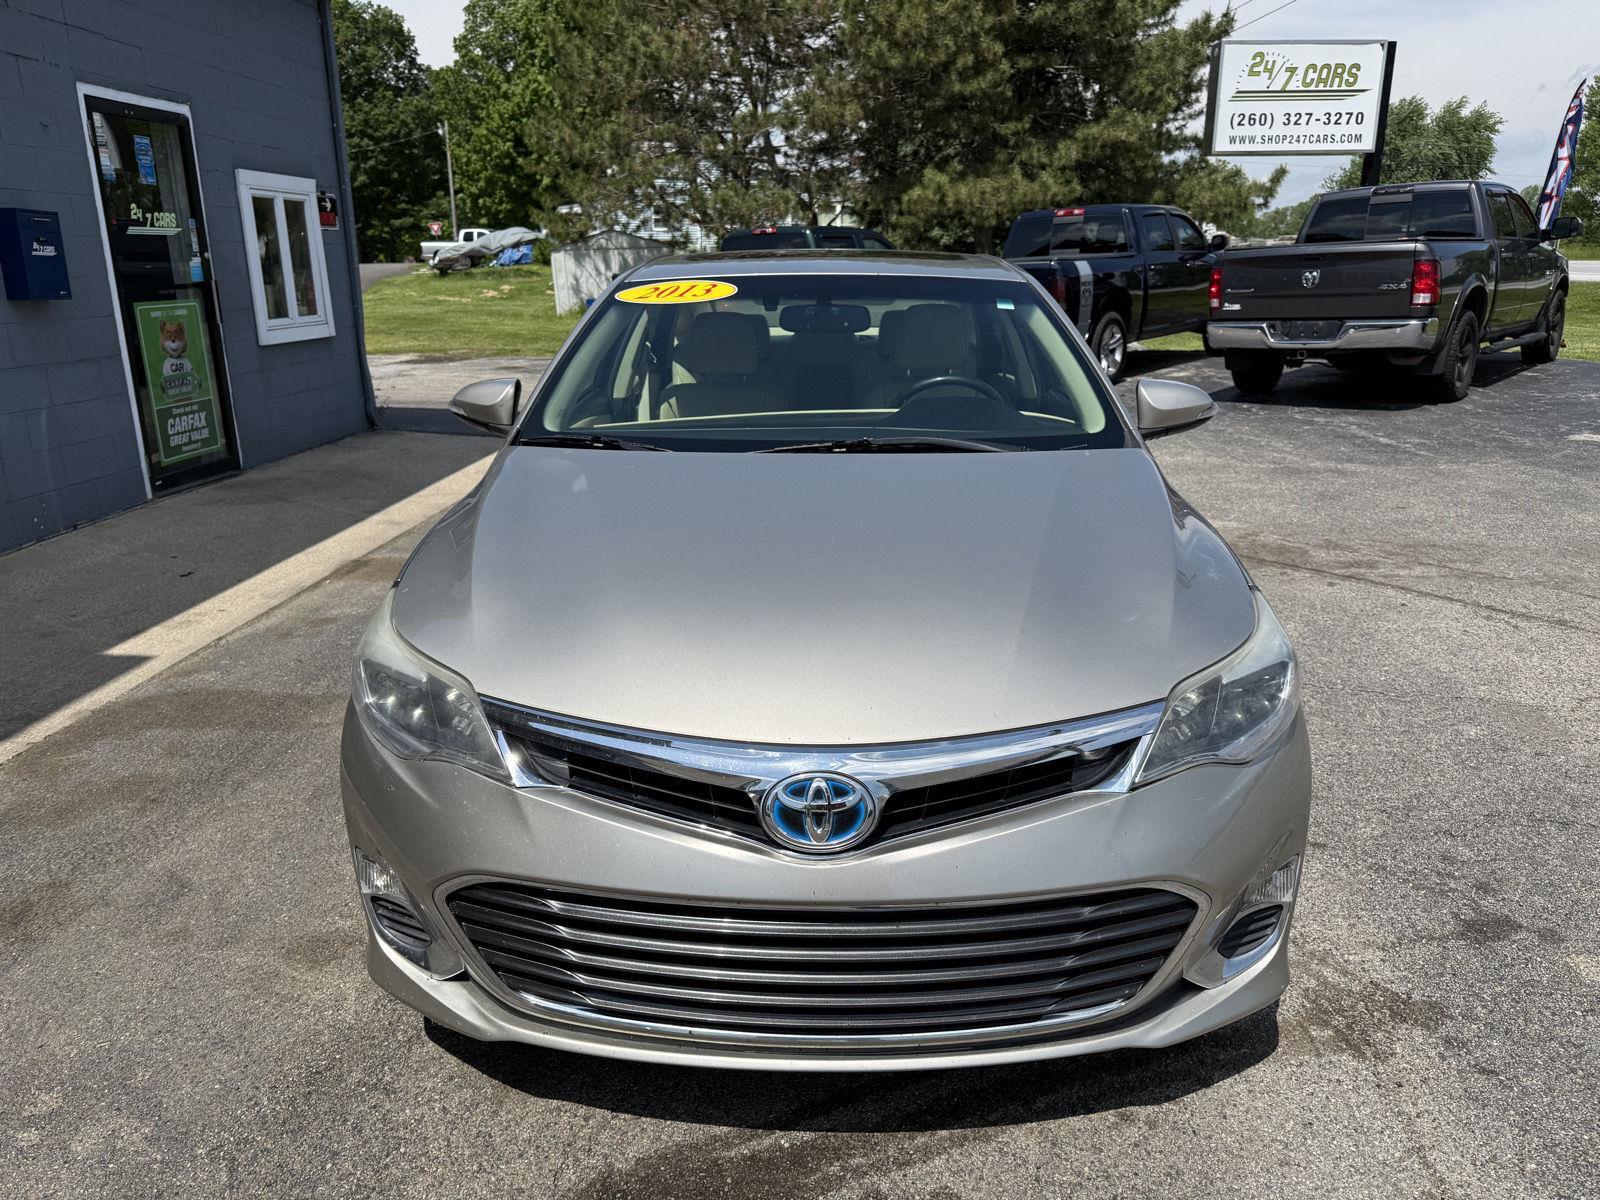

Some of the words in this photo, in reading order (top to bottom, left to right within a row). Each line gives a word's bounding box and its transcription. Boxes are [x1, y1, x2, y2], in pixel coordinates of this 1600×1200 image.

[1301, 63, 1361, 88] CARS
[1230, 112, 1275, 129] (260)
[1282, 112, 1365, 126] 327-3270
[1228, 133, 1363, 145] WWW.SHOP247CARS.COM
[153, 212, 177, 228] CARS
[633, 283, 718, 300] 2013
[170, 362, 185, 373] CAR
[167, 411, 207, 435] CARFAX
[169, 432, 190, 447] GREAT
[190, 428, 210, 441] VALUE
